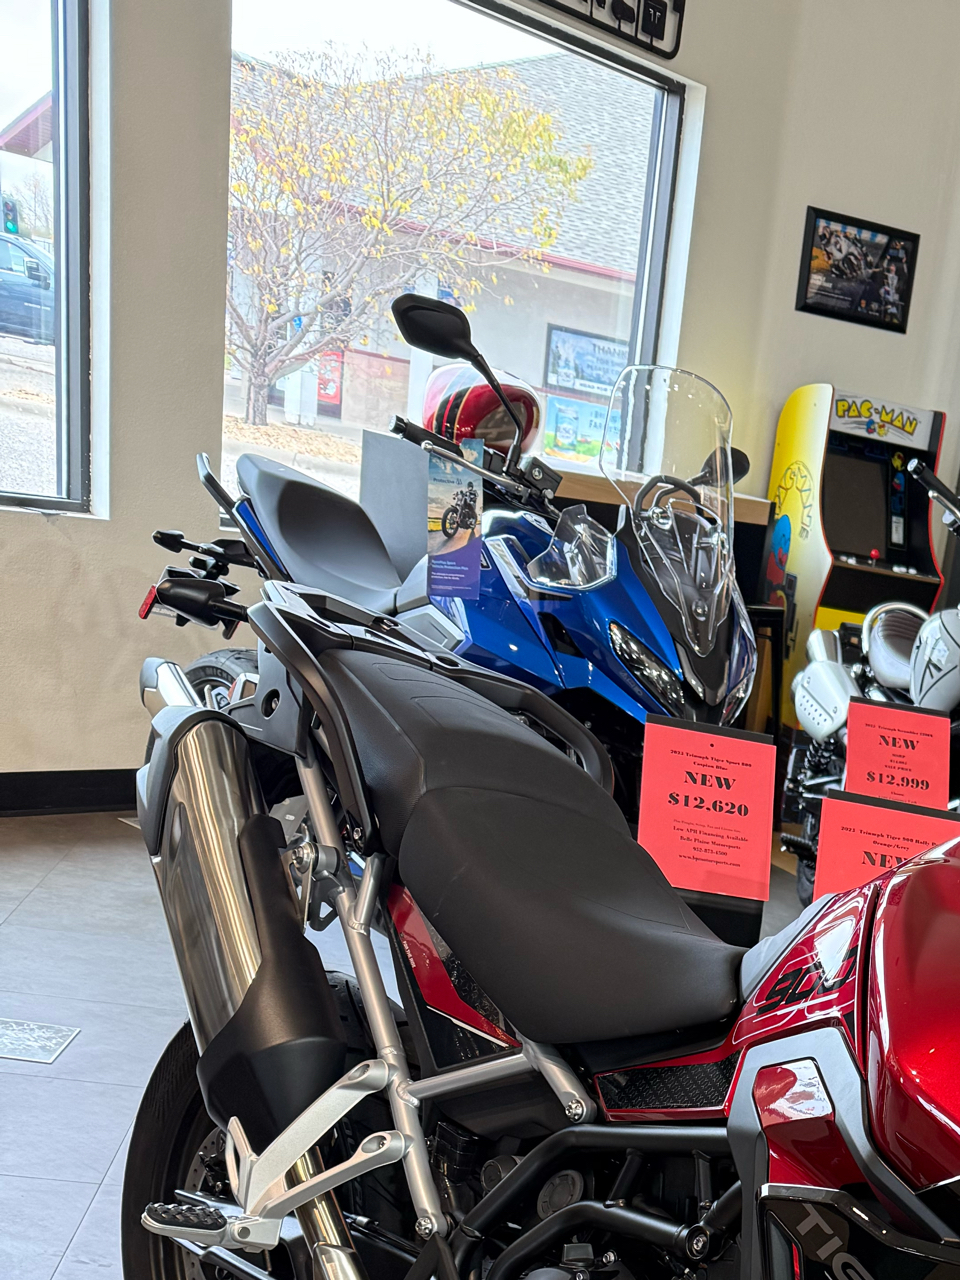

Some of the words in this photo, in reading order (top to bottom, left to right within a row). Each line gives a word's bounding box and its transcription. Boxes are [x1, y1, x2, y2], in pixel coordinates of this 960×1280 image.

[835, 398, 918, 437] PAC-MAN
[878, 735, 919, 750] NEW
[685, 752, 709, 760] Triumph
[684, 771, 736, 790] NEW
[866, 771, 930, 790] $12,999
[668, 792, 749, 816] $12,620
[699, 829, 724, 839] Financing
[726, 834, 748, 842] Available
[860, 829, 884, 838] Triumph
[872, 840, 910, 851] Orange/Grey
